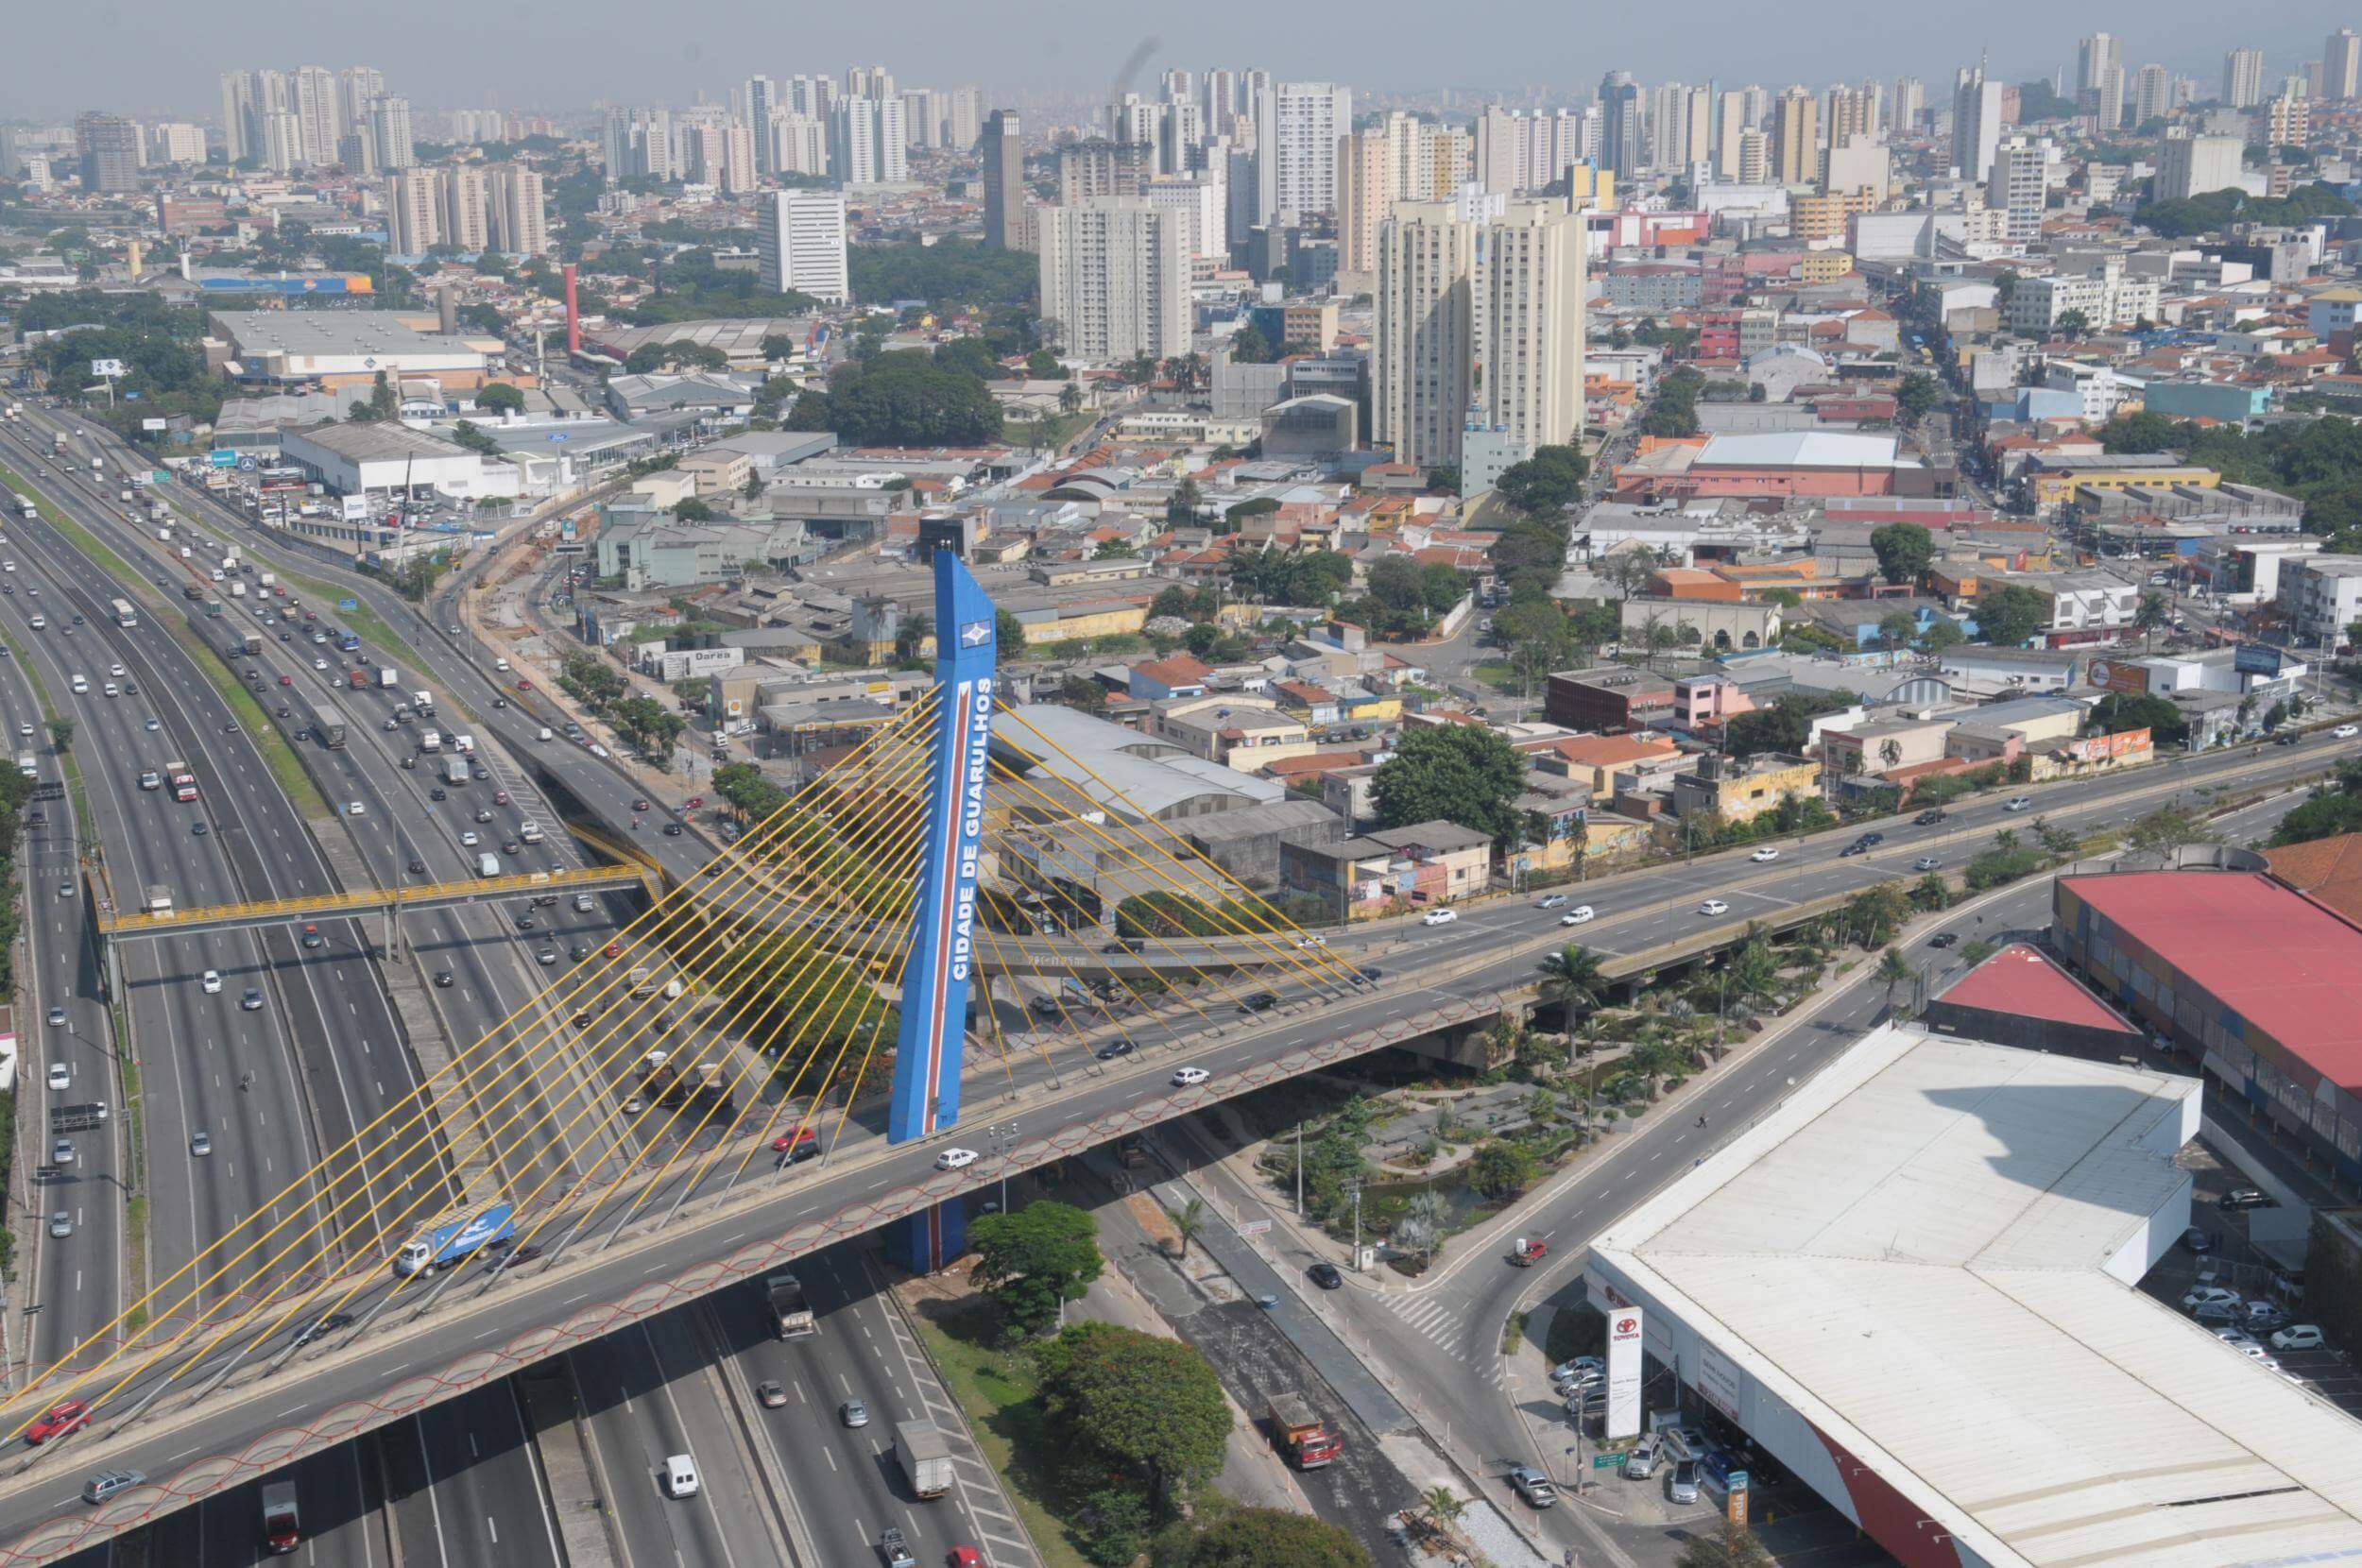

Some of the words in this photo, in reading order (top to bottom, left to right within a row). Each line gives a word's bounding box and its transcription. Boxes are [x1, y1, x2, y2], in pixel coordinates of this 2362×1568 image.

[965, 677, 992, 837] GUARULHOS
[962, 844, 978, 878] DE
[952, 886, 974, 980] CIDADE
[1614, 1333, 1639, 1341] TOYOTA
